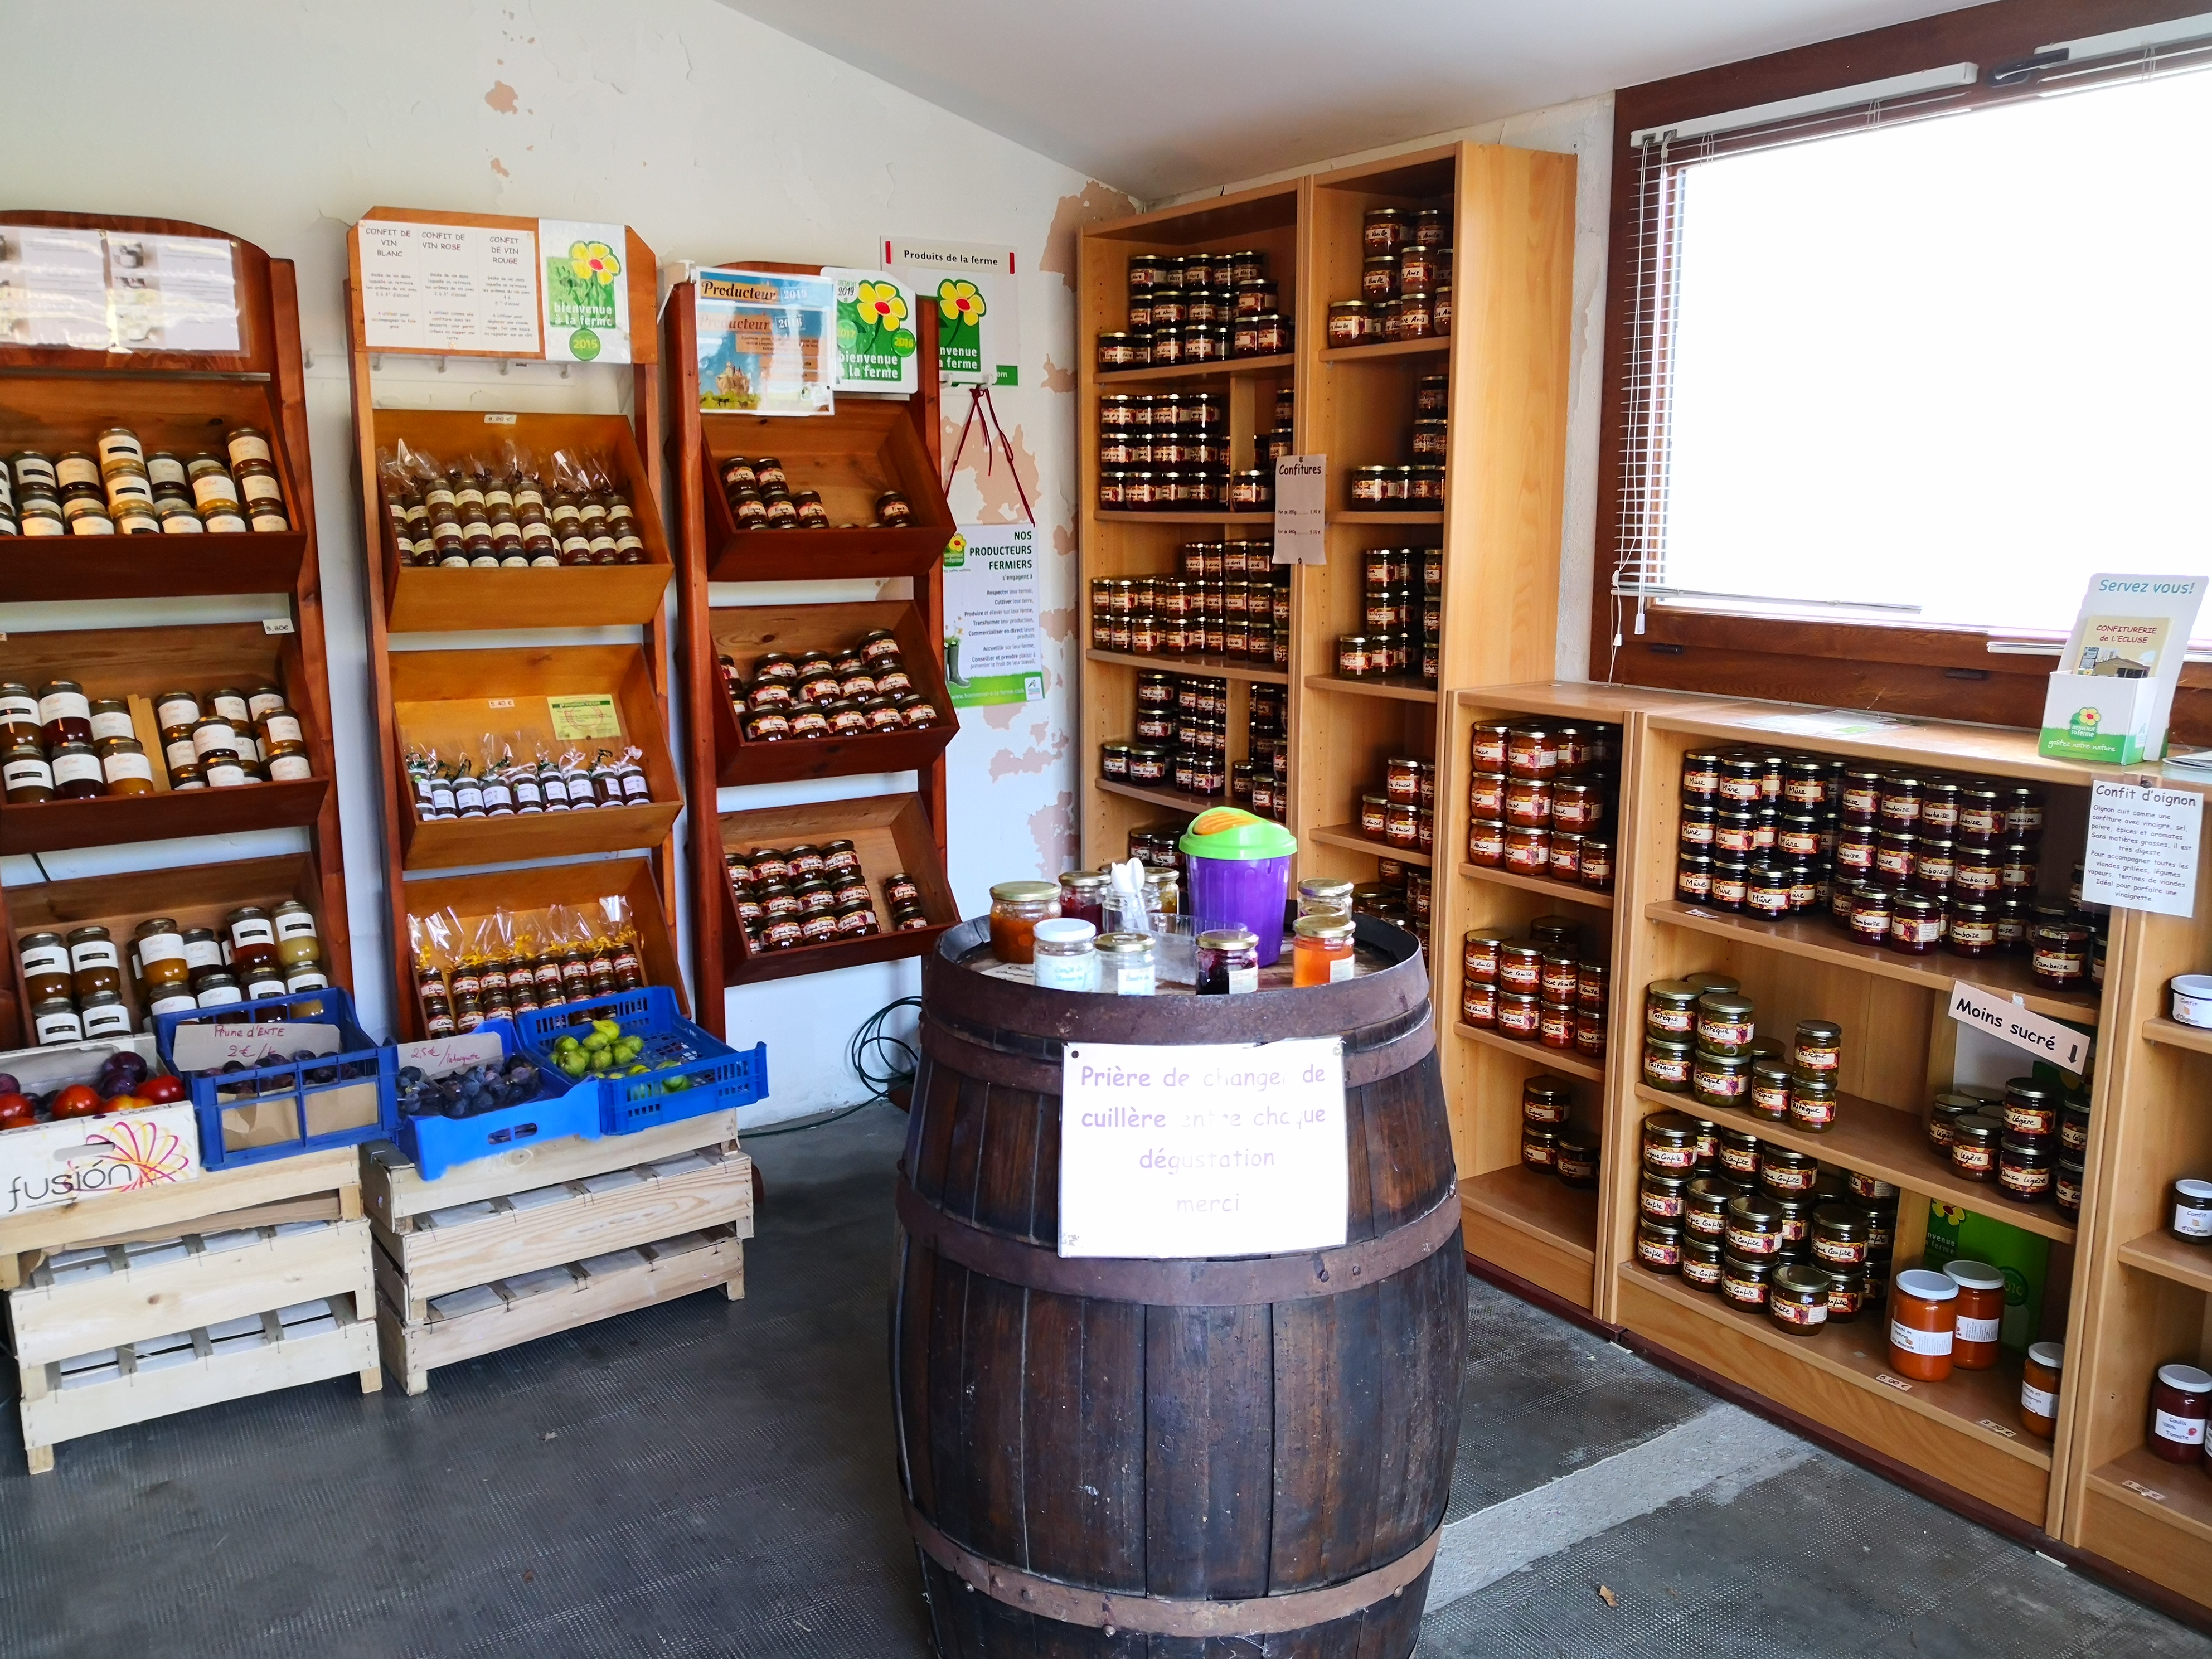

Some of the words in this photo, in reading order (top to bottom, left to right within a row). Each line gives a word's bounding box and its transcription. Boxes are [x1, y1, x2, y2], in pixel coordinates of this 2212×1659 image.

[904, 250, 943, 261] Produits
[946, 254, 957, 262] de
[961, 255, 968, 263] la
[971, 256, 998, 265] ferme
[701, 281, 777, 300] Producteur
[838, 287, 854, 296] 2019
[554, 302, 612, 314] bienvenue
[566, 315, 576, 324] la
[574, 339, 598, 349] 2015
[894, 337, 913, 348] 2016
[839, 351, 898, 365] bienvenue
[940, 347, 977, 357] nvenue
[947, 357, 977, 370] ferme
[849, 365, 860, 377] la
[864, 365, 898, 379] ferme
[1279, 463, 1321, 476] Confitures
[1014, 531, 1032, 540] NOS
[969, 545, 1032, 556] PRODUCTEURS
[989, 560, 1032, 570] FERMIERS
[2098, 579, 2149, 593] Servez
[2153, 582, 2195, 595] vous!
[2095, 625, 2157, 634] CONFITURERIE
[2111, 636, 2148, 644] L'ECLUSE
[2096, 785, 2136, 799] Confit
[2142, 790, 2196, 807] d'oignon
[2093, 804, 2114, 813] Oignon
[2092, 814, 2122, 823] confiture
[2142, 821, 2172, 830] vinaigre,
[2092, 823, 2112, 833] poivre,
[2116, 826, 2137, 835] épices
[2150, 831, 2185, 841] aromates.
[2109, 835, 2138, 844] matières
[2141, 840, 2170, 848] grasses,
[2135, 848, 2161, 856] digeste
[2107, 854, 2150, 865] accompagner
[2153, 859, 2176, 868] toutes
[2096, 861, 2120, 869] viandes
[2123, 865, 2150, 875] grillées,
[2154, 869, 2181, 879] légumes
[2088, 869, 2114, 879] vapeurs,
[2118, 873, 2145, 882] terrines
[2160, 879, 2187, 889] viandes.
[2133, 885, 2162, 894] parfaire
[1752, 894, 1773, 904] Mûre
[2115, 891, 2154, 902] vinaigrette.
[2035, 956, 2069, 971] Framboise
[215, 1025, 243, 1037] Prune
[1956, 998, 2002, 1027] Moins
[2010, 1023, 2055, 1051] sucré
[1081, 1065, 1151, 1087] Prière
[1163, 1067, 1190, 1087] de
[1302, 1063, 1326, 1084] de
[1081, 1107, 1166, 1128] cuillère
[1139, 1147, 1275, 1176] dégustation
[8, 1159, 132, 1212] fusión
[1177, 1193, 1240, 1213] merci
[1927, 1231, 1955, 1247] nvenue
[1932, 1239, 1954, 1255] ferme
